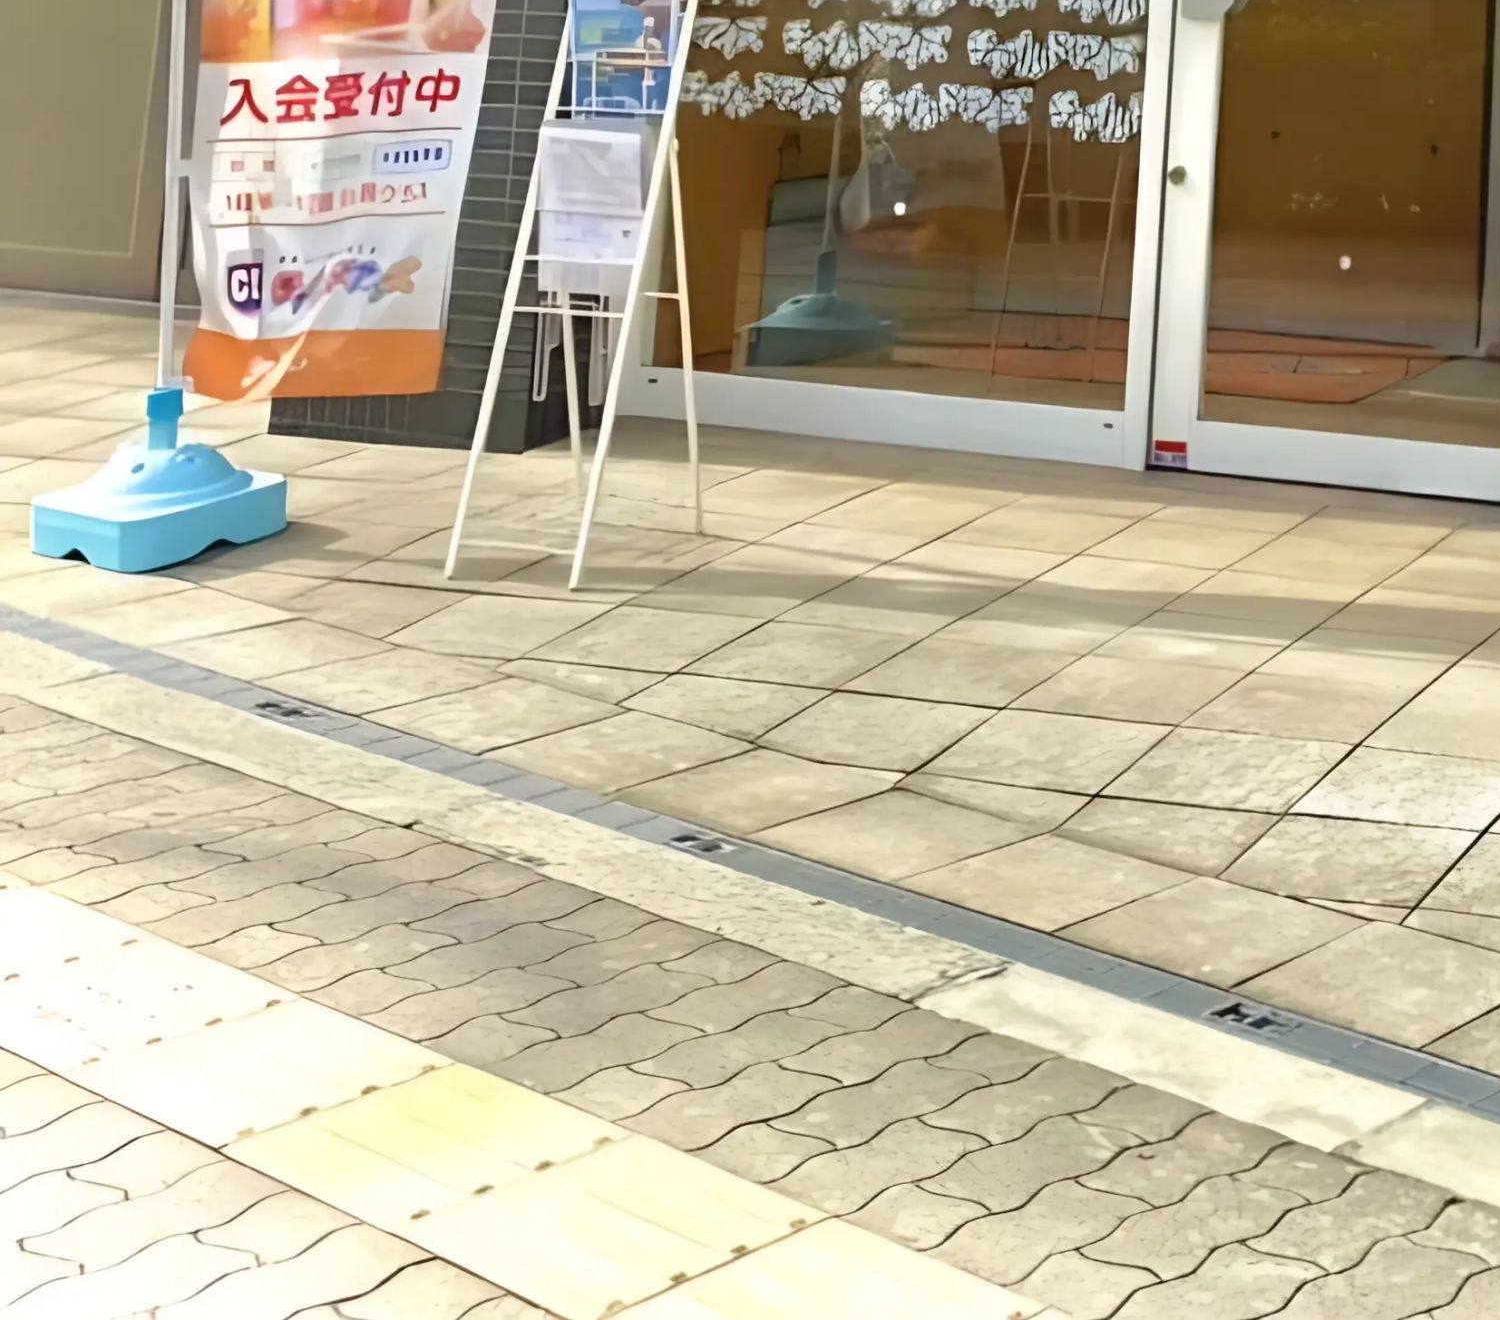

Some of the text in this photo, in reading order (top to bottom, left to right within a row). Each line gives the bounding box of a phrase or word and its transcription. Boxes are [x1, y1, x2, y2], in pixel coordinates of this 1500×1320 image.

[220, 68, 460, 126] 入会受付中
